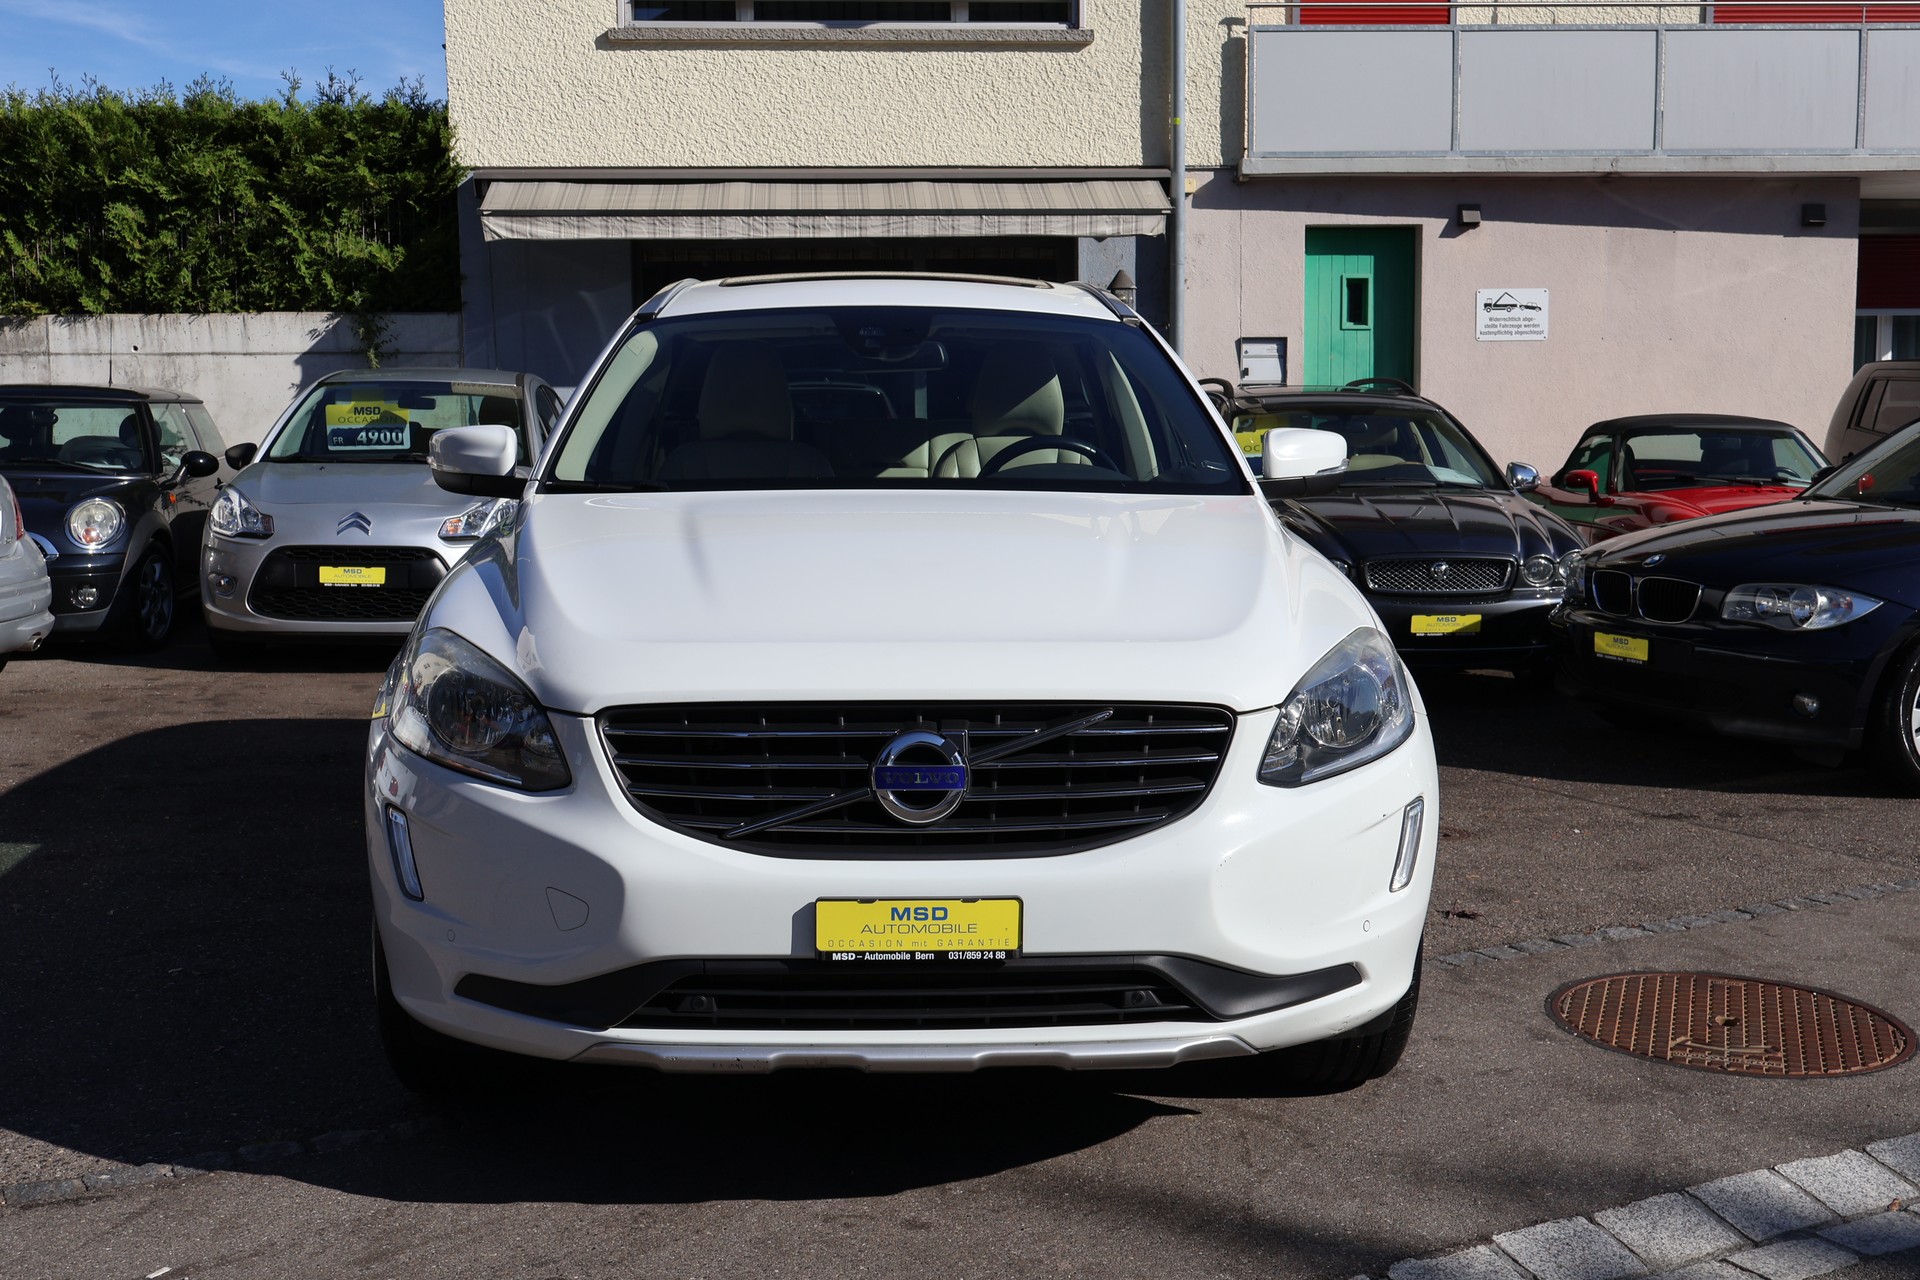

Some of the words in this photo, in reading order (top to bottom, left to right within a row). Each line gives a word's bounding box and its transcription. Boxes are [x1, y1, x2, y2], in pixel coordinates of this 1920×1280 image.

[353, 406, 381, 416] MSD
[337, 416, 397, 424] OCCASION
[332, 436, 344, 445] FR
[357, 428, 403, 445] 4900
[1612, 637, 1629, 645] MSD
[881, 771, 960, 784] VOLVO
[890, 906, 948, 921] MSD
[860, 923, 978, 934] AUTOMOBILE
[827, 939, 903, 948] OCCASION
[911, 940, 928, 948] mit
[937, 938, 1010, 947] GARANTIE
[832, 952, 856, 961] MSD
[864, 951, 911, 961] Automobile
[915, 951, 935, 960] Bern
[948, 951, 982, 960] 031/859
[983, 951, 994, 960] 24
[995, 951, 1006, 960] 88
